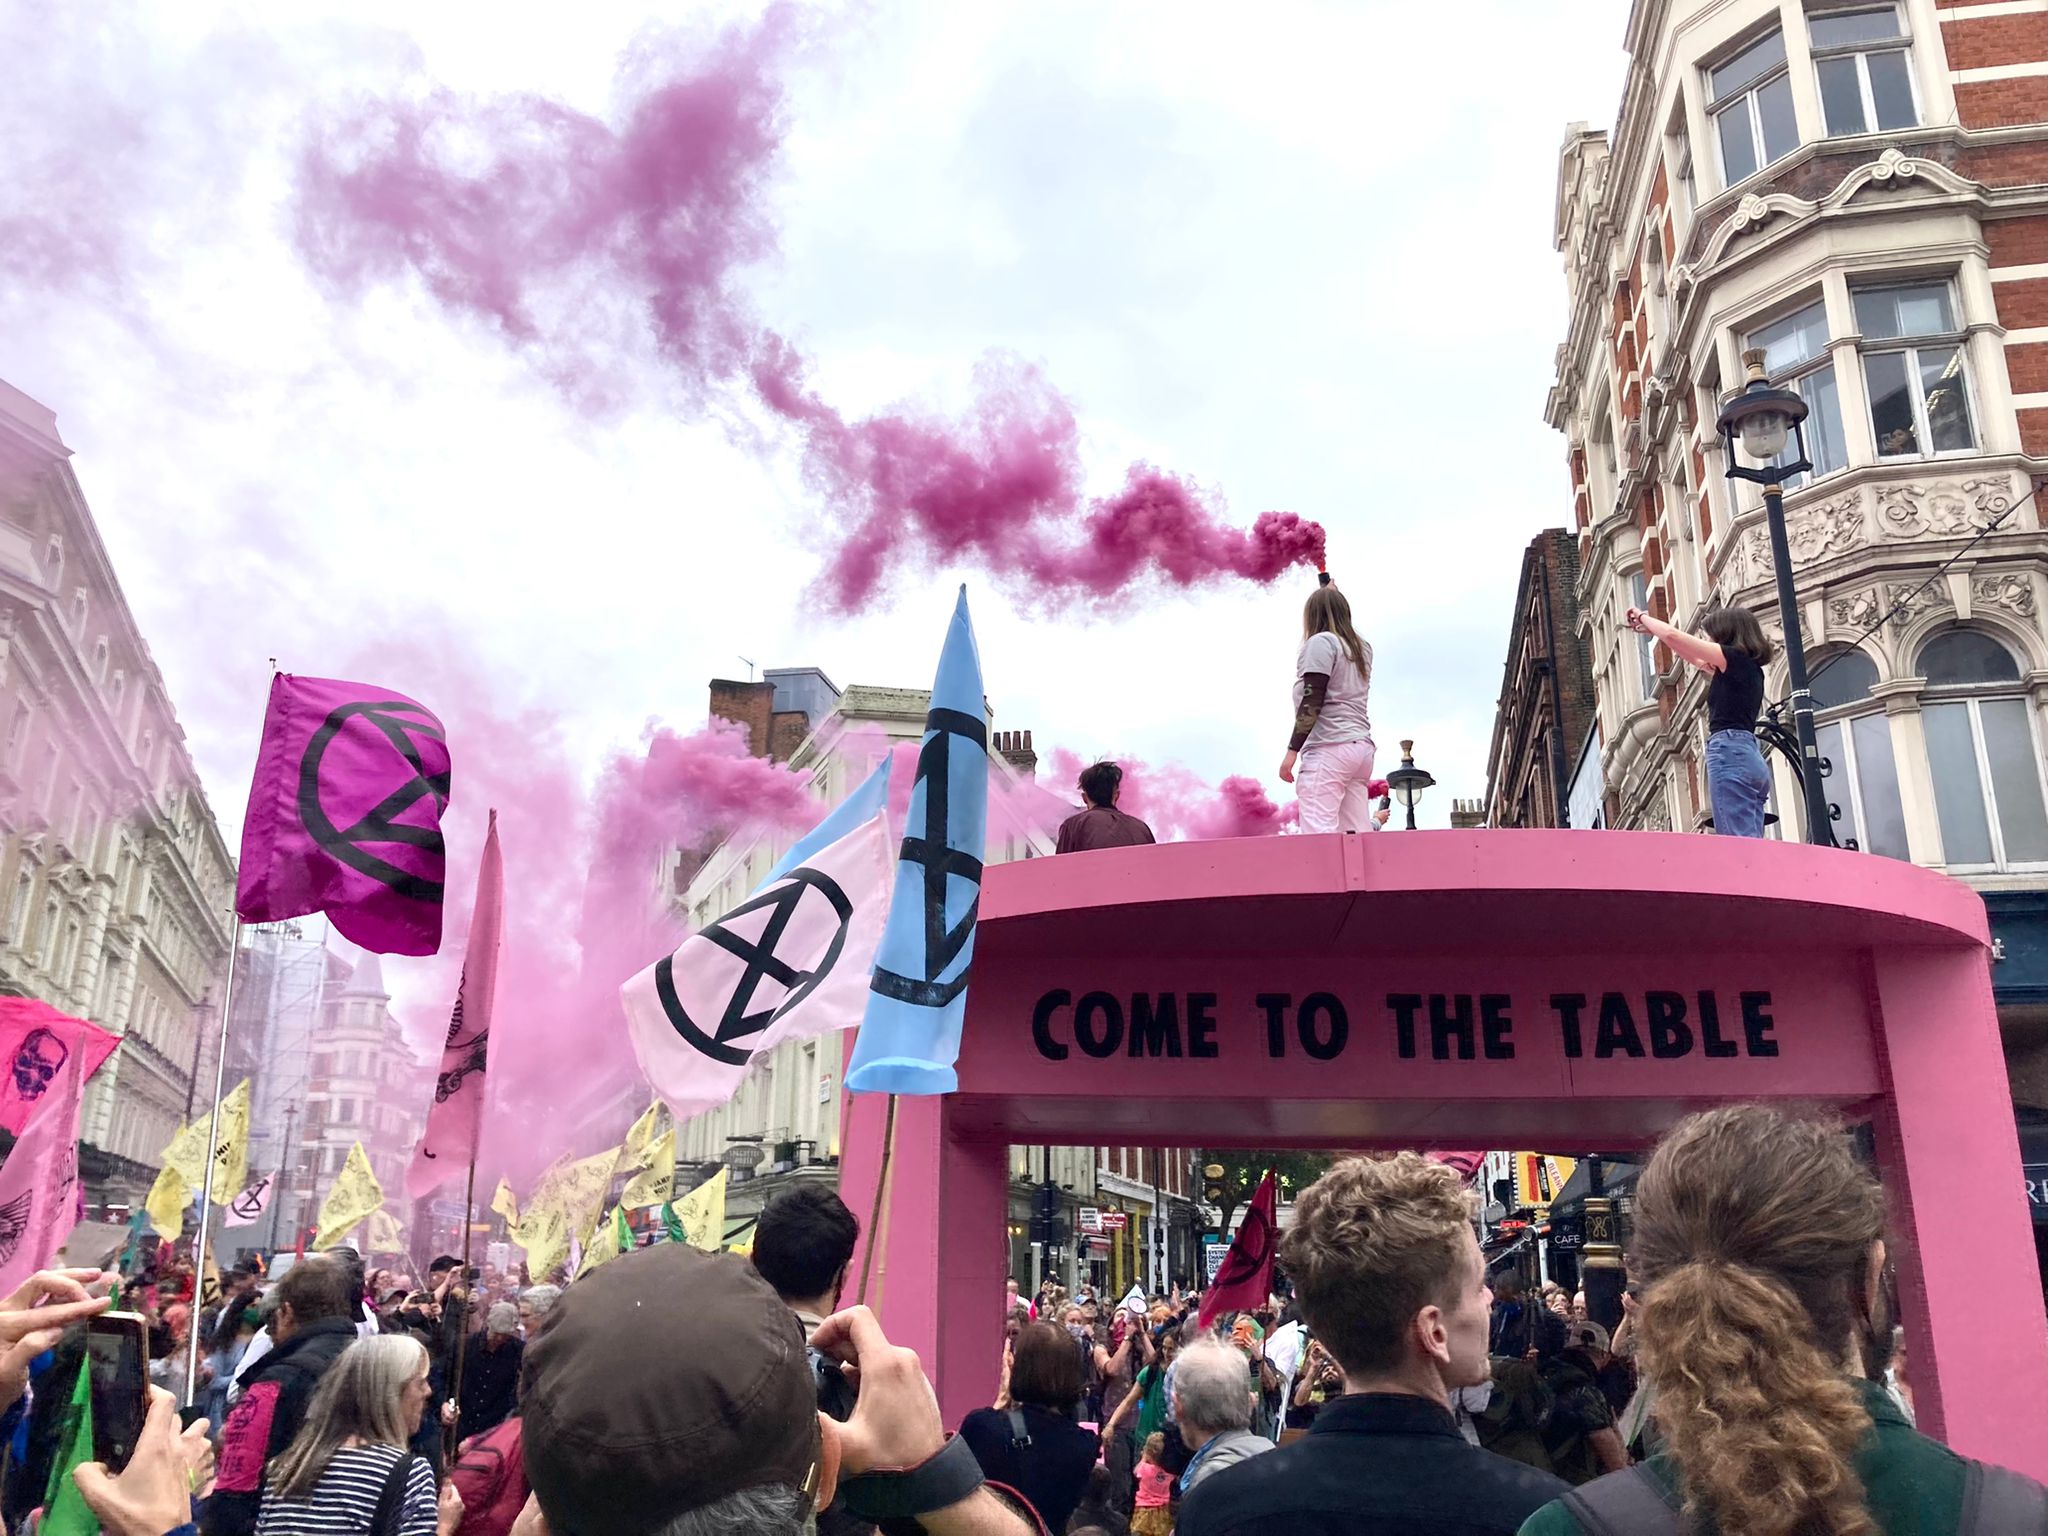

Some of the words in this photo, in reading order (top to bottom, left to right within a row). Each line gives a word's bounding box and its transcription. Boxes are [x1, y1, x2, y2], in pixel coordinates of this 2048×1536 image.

[1032, 988, 1219, 1061] COME
[1256, 991, 1349, 1060] TO
[1386, 993, 1515, 1060] THE
[1550, 990, 1779, 1059] TABLE
[1554, 1234, 1581, 1245] CAFE
